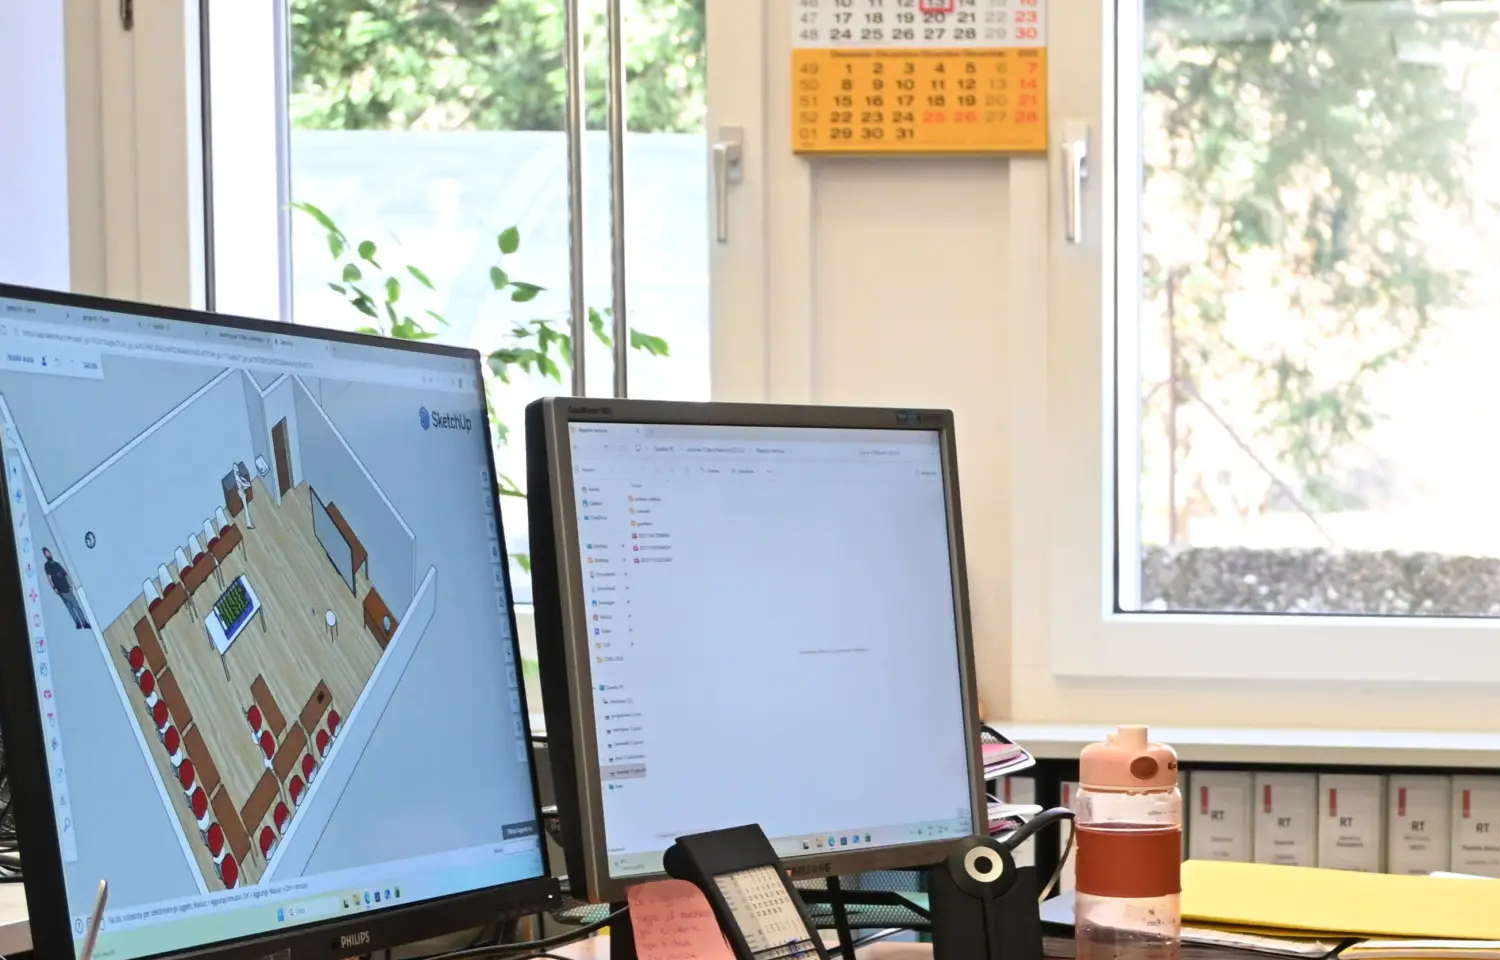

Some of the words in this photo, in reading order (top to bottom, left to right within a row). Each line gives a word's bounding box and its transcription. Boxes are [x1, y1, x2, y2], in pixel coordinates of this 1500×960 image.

[834, 12, 853, 24] 17
[865, 12, 884, 24] 18
[896, 12, 915, 24] 19
[923, 12, 946, 24] 20
[957, 12, 977, 24] 21
[1014, 12, 1038, 24] 23
[830, 28, 853, 40] 24
[861, 28, 884, 40] 25
[892, 28, 915, 40] 26
[923, 28, 946, 40] 27
[953, 28, 977, 40] 28
[1014, 28, 1038, 40] 30
[845, 62, 853, 74] 1
[873, 62, 884, 74] 2
[904, 62, 915, 74] 3
[935, 62, 946, 74] 4
[966, 62, 977, 74] 5
[1027, 62, 1038, 74] 7
[842, 78, 853, 90] 8
[873, 78, 884, 90] 9
[896, 78, 915, 90] 10
[931, 78, 946, 90] 11
[957, 78, 977, 90] 12
[1018, 78, 1038, 90] 14
[834, 95, 853, 107] 15
[865, 95, 884, 107] 16
[896, 95, 915, 107] 17
[927, 95, 946, 107] 18
[957, 95, 977, 107] 19
[1014, 95, 1038, 107] 21
[830, 111, 853, 123] 22
[861, 111, 884, 123] 23
[892, 111, 915, 123] 24
[1014, 111, 1038, 123] 28
[830, 127, 853, 140] 29
[861, 127, 884, 140] 30
[896, 127, 915, 140] 31
[431, 409, 473, 433] SketchUp
[1210, 810, 1225, 821] RT
[1277, 817, 1291, 828] RT
[1339, 817, 1353, 828] RT
[1411, 821, 1425, 831] RT
[1476, 822, 1490, 833] RT
[340, 930, 371, 949] PHILIPS
